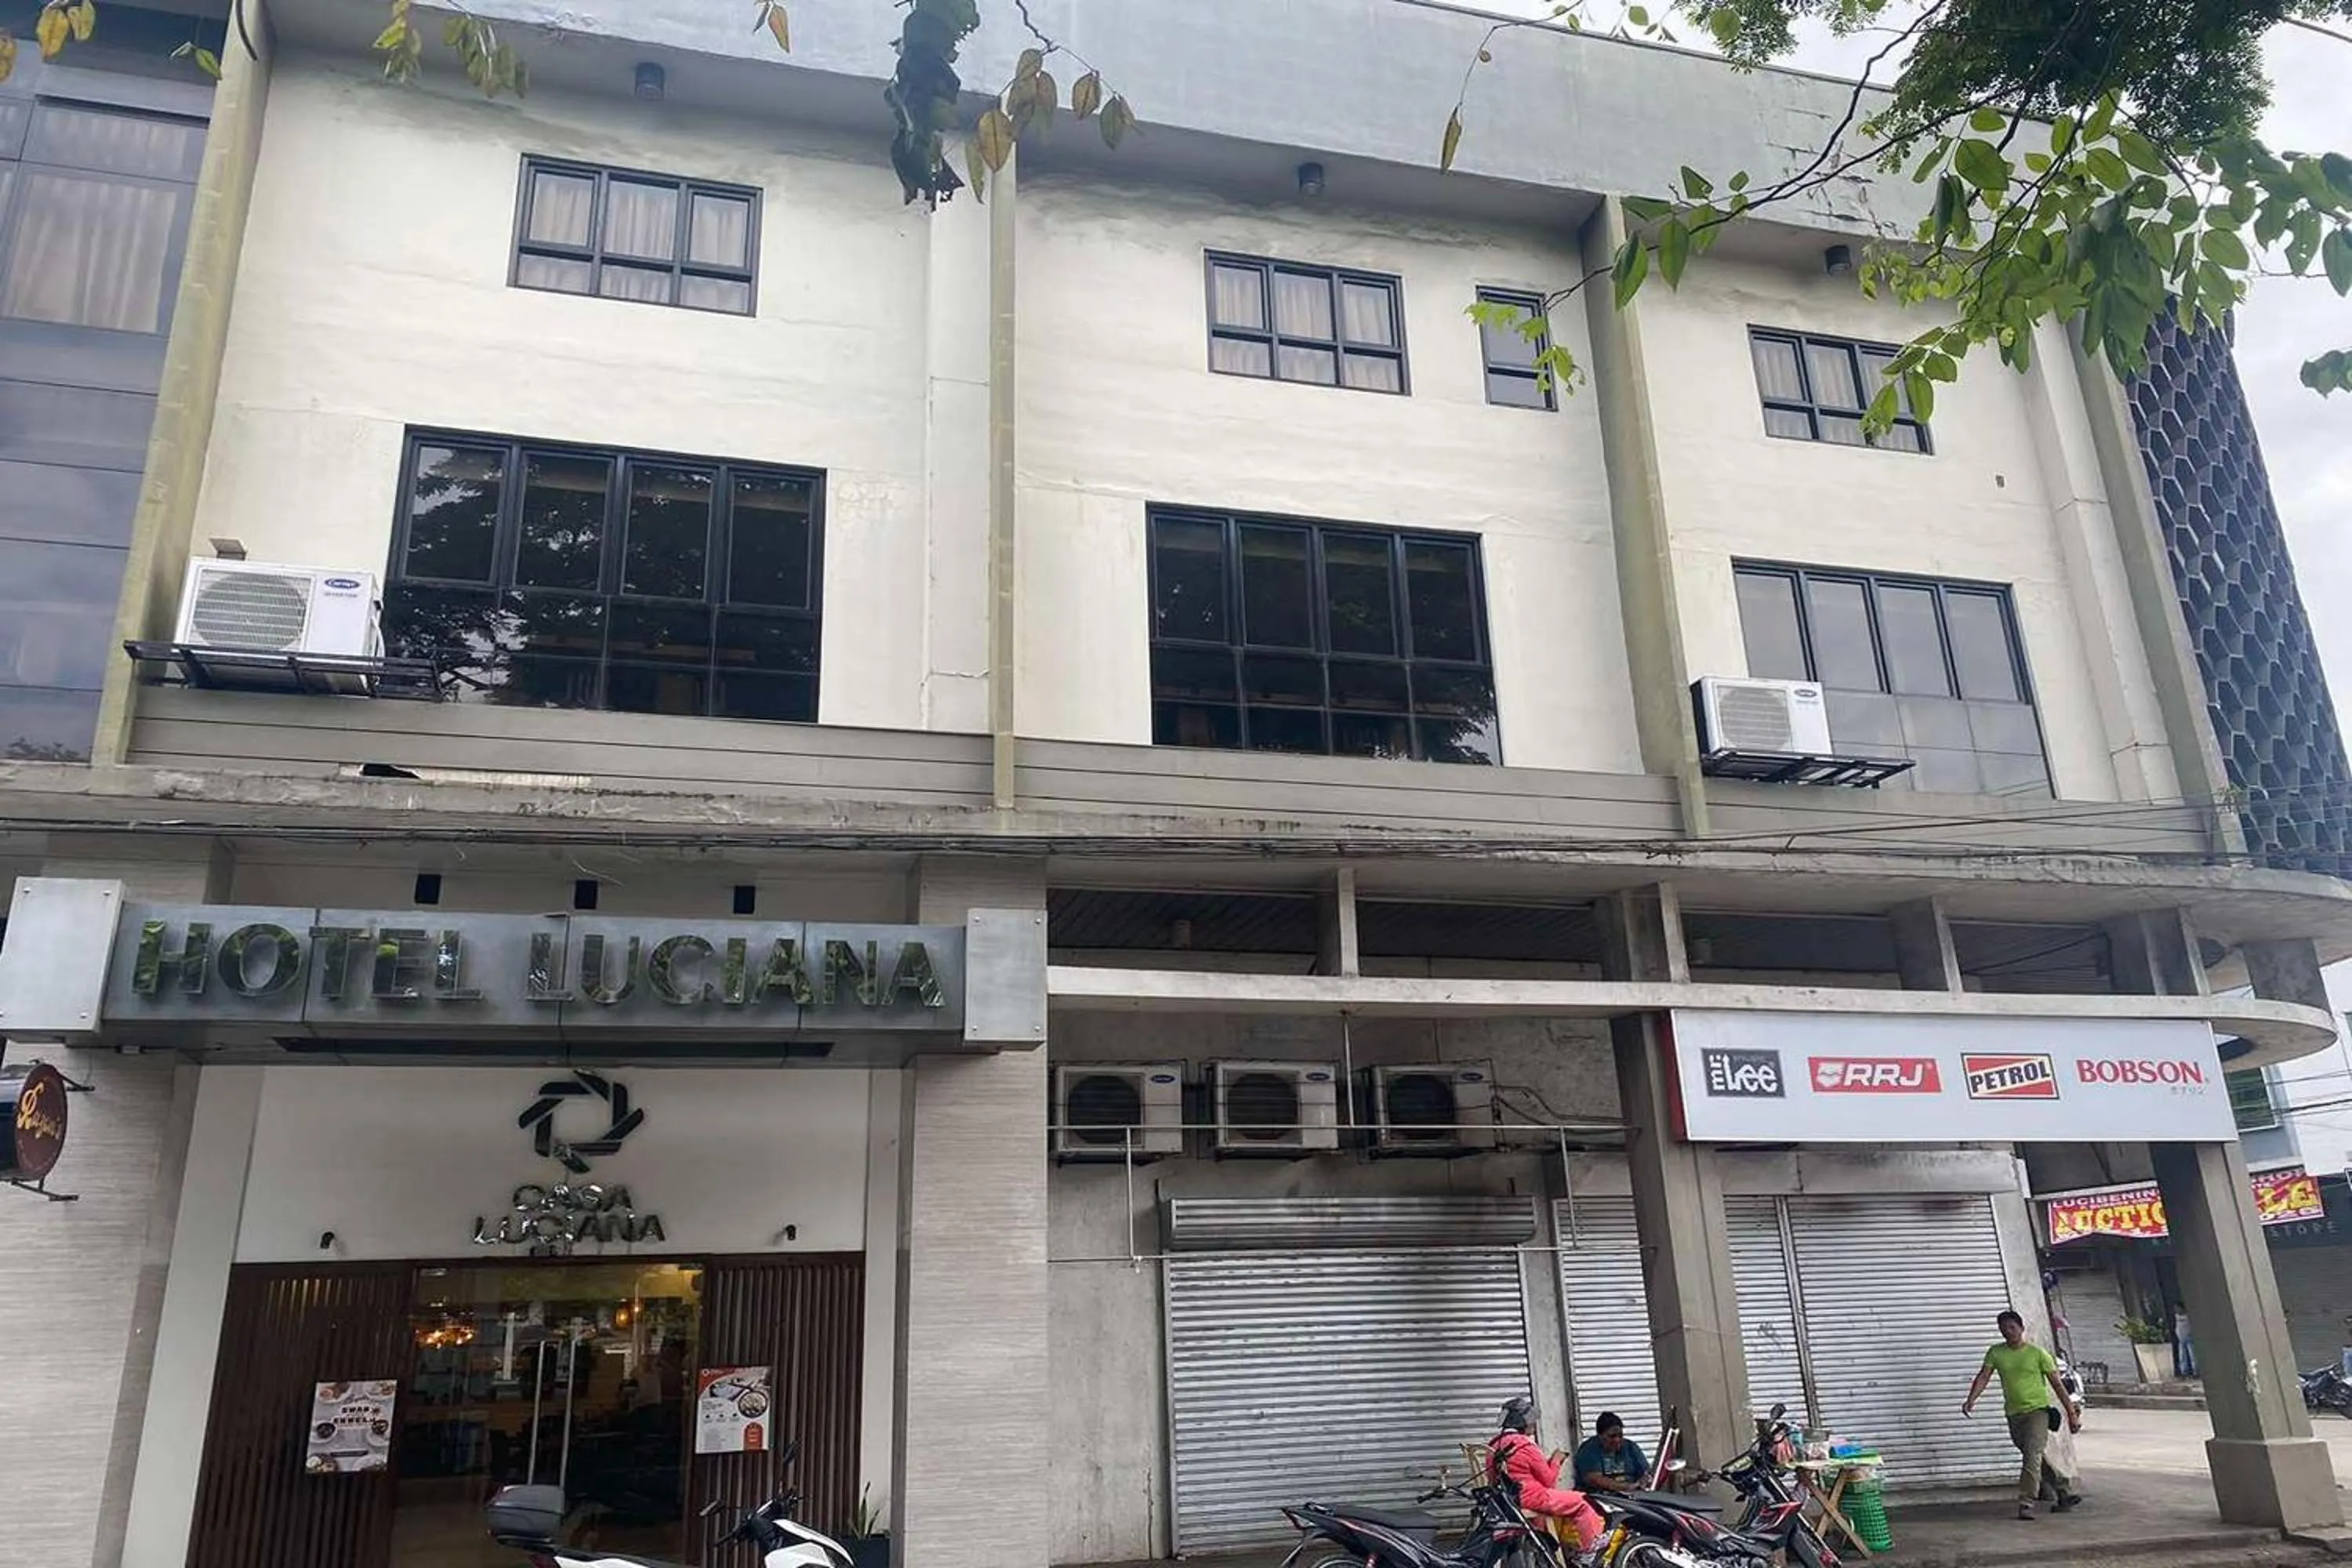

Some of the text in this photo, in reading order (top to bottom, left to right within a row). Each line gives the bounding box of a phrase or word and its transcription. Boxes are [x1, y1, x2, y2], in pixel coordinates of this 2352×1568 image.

[132, 920, 946, 1007] HOTEL LUCIANA
[1844, 1063, 1923, 1087] RRJ
[1969, 1061, 2050, 1093] PETROL
[2076, 1059, 2203, 1083] BOBSON
[512, 1181, 633, 1214] CASA
[2053, 1189, 2159, 1208] LUCIBENIN
[474, 1214, 665, 1244] LUCIANA
